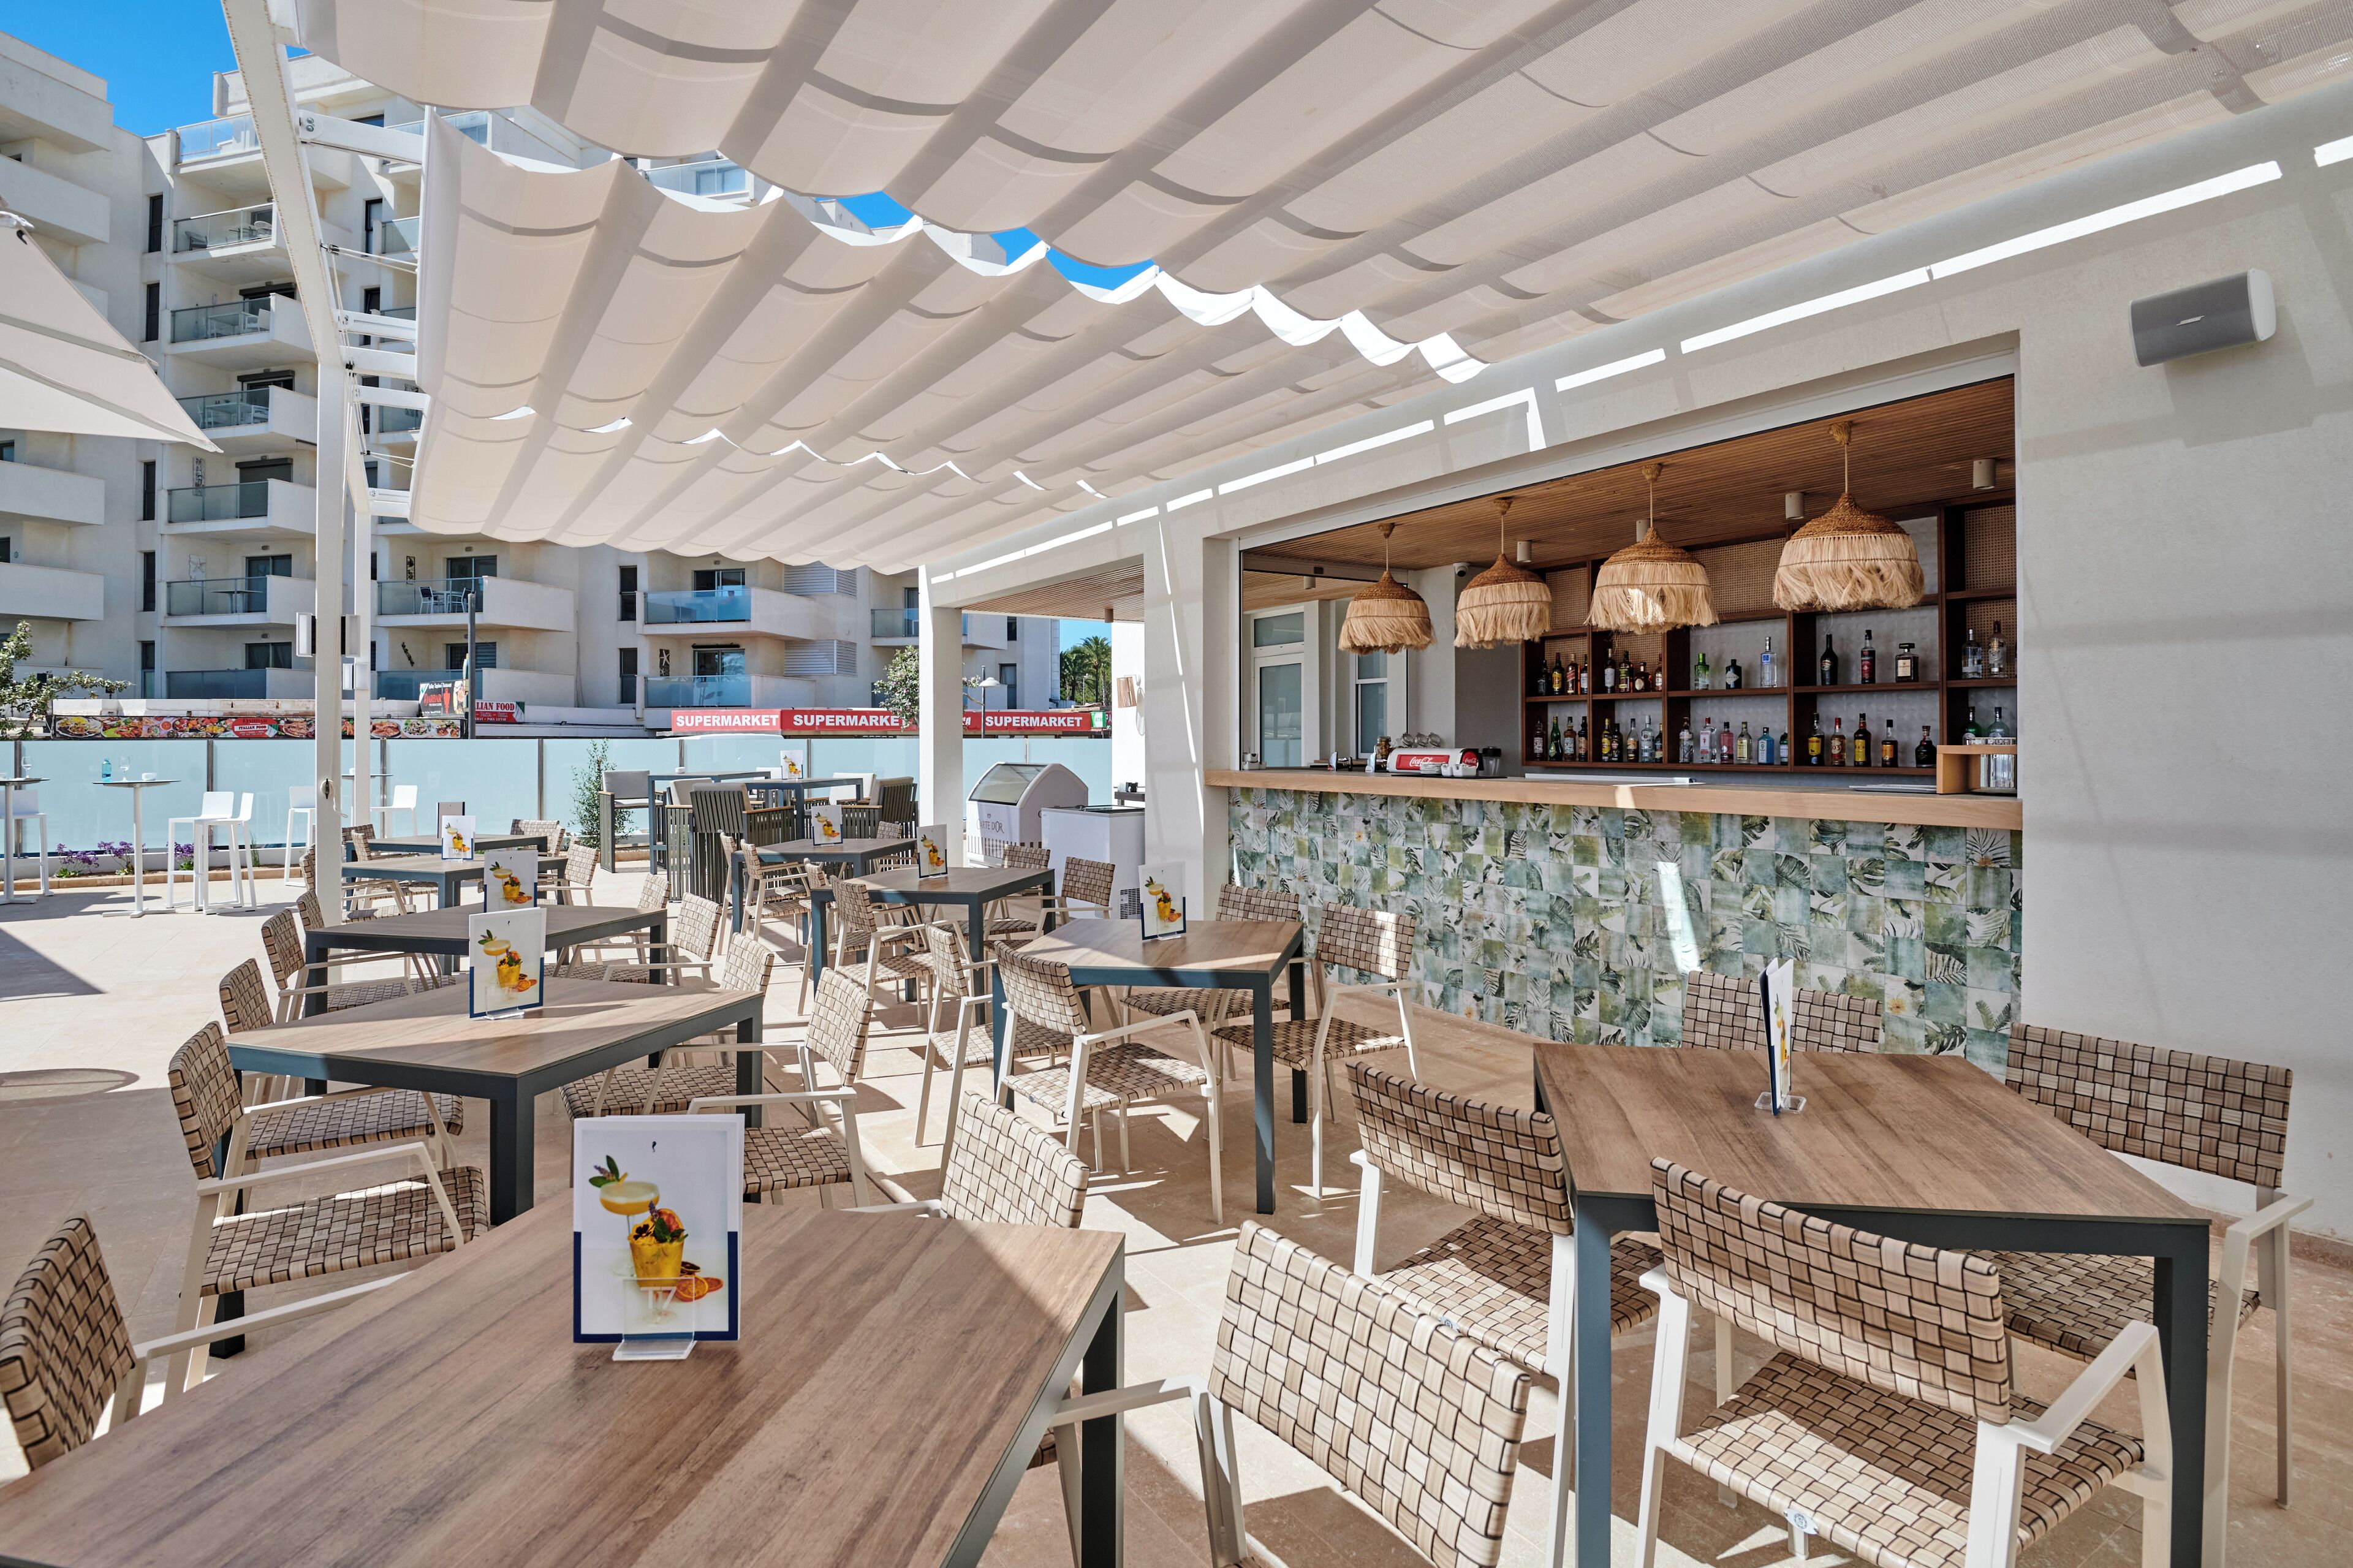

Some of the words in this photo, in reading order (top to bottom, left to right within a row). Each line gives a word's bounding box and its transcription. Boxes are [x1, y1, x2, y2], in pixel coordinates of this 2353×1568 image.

[476, 702, 495, 710] LIAN
[496, 702, 515, 711] FOOD
[676, 714, 779, 727] SUPERMARKET
[985, 716, 1083, 727] SUPERMARKET
[1409, 756, 1433, 767] Coca-C
